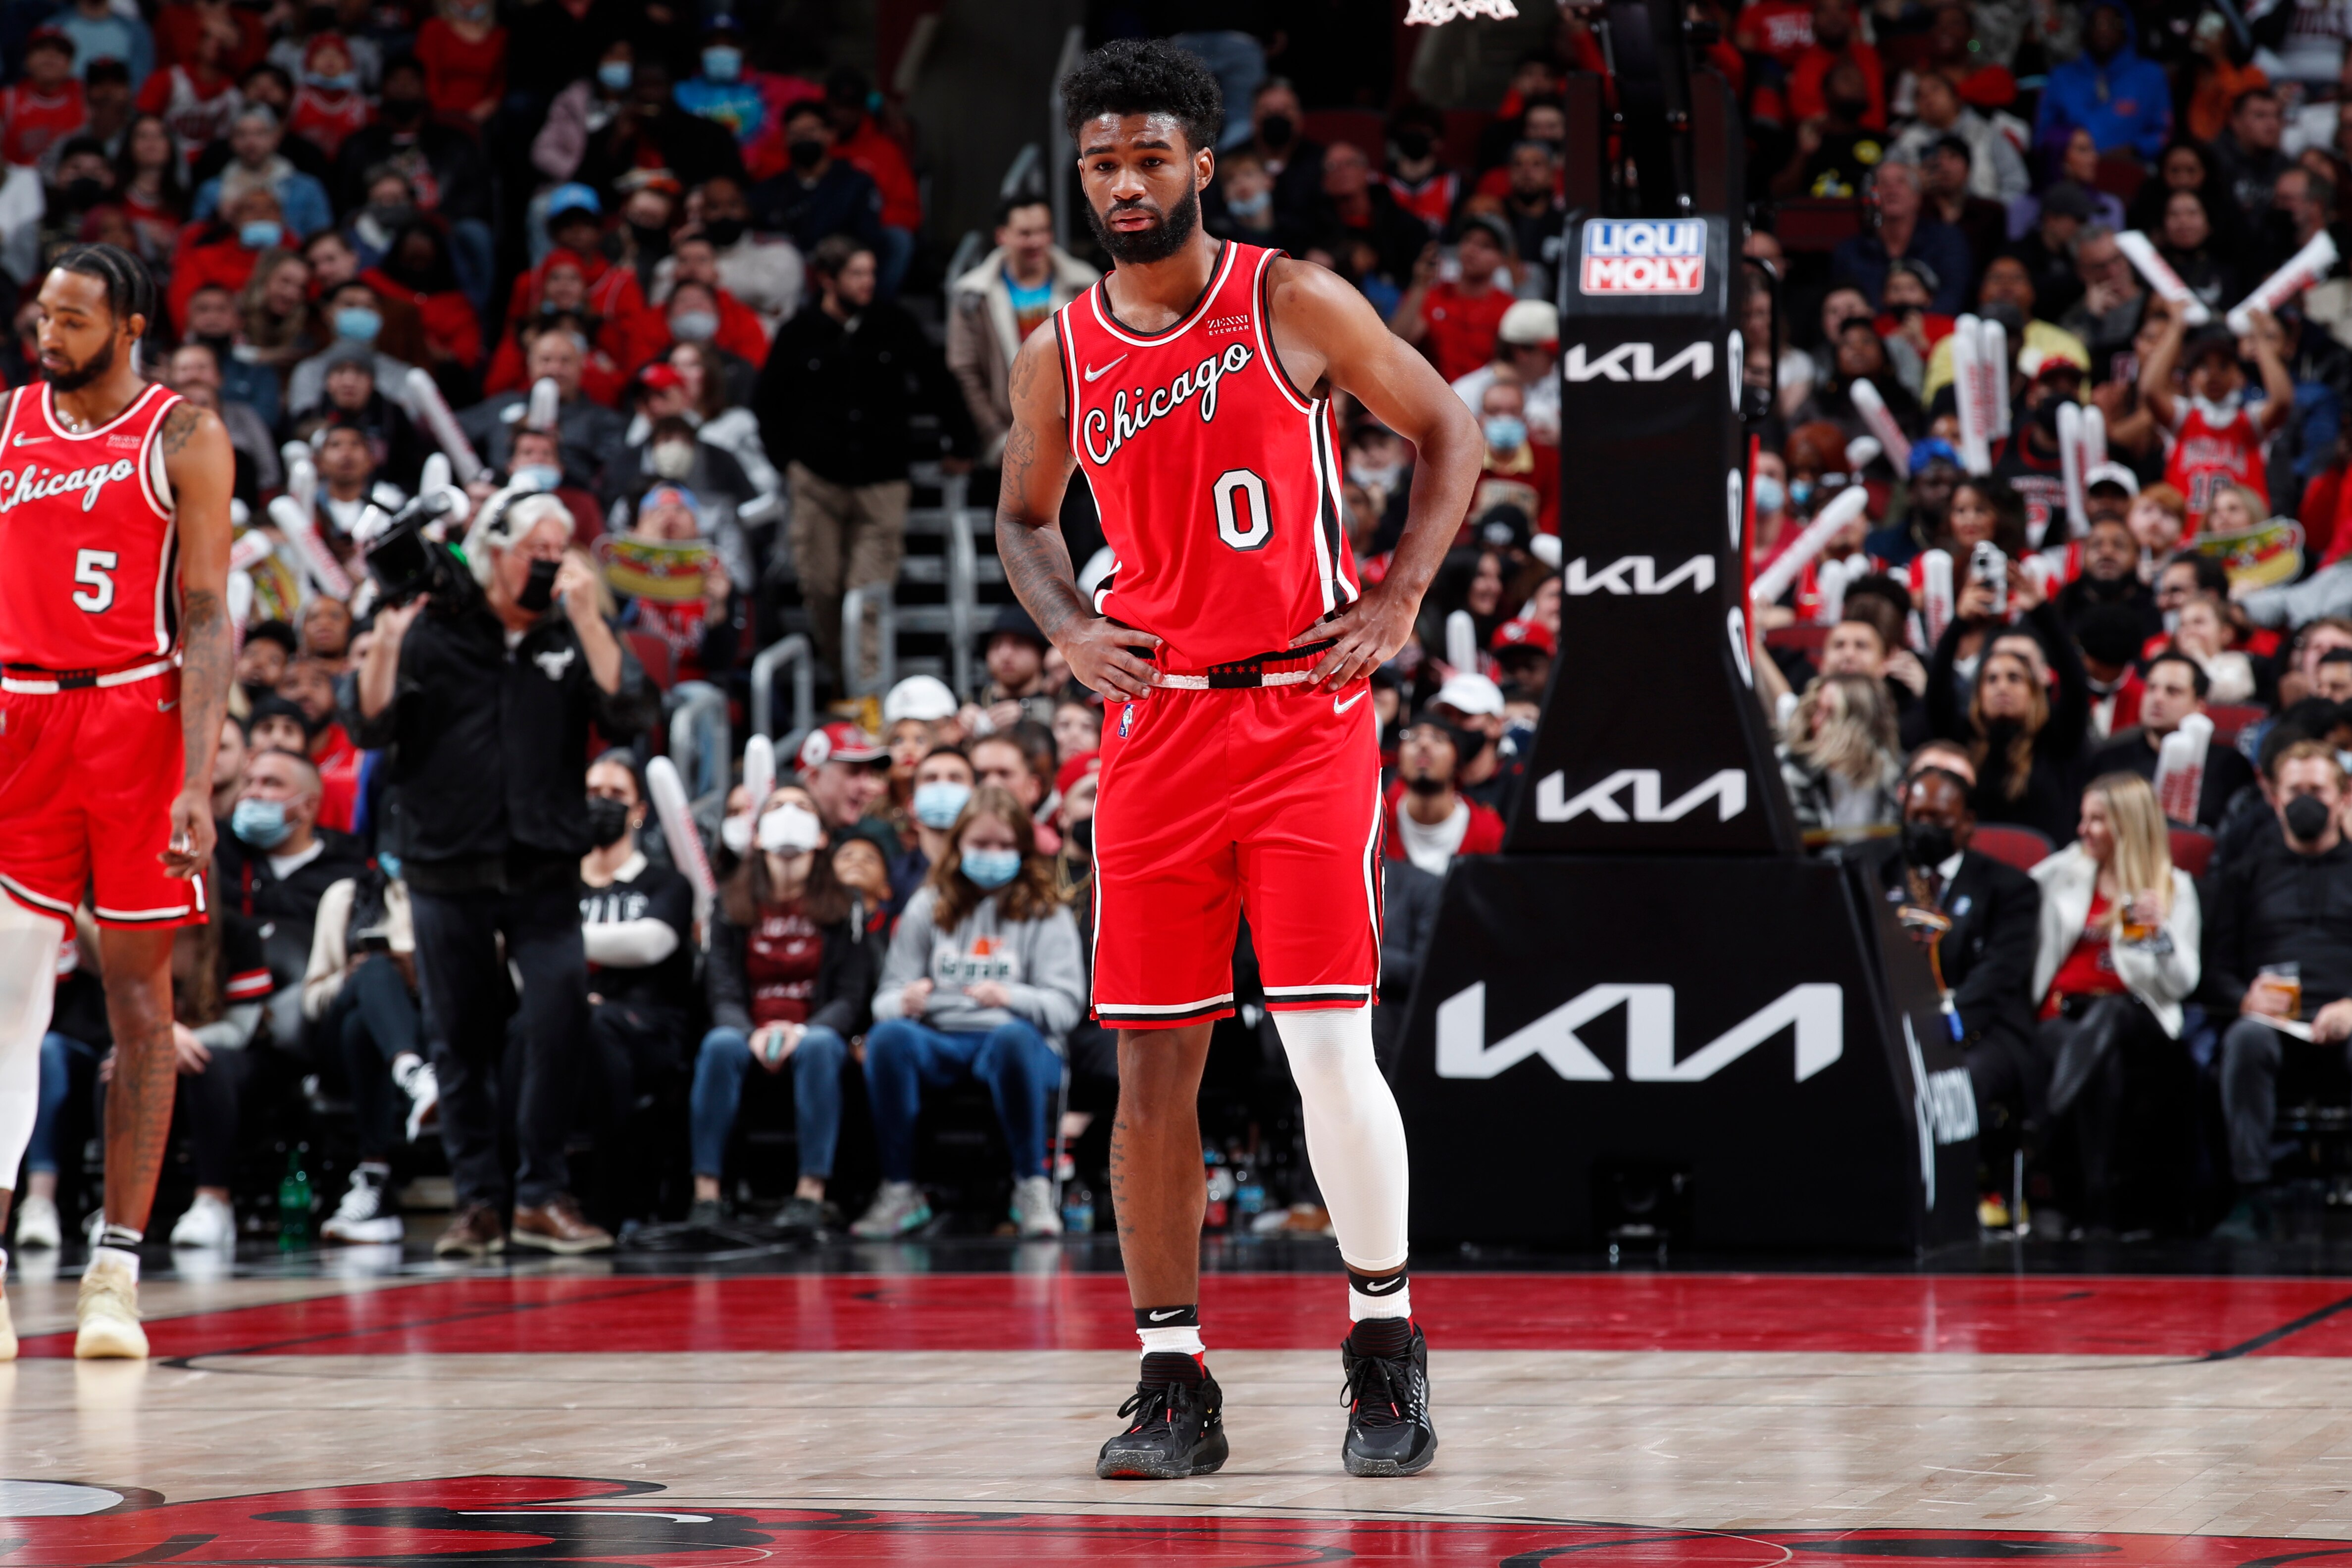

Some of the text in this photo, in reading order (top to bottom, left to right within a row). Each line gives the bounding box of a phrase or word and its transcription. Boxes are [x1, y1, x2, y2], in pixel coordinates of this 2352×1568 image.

[1591, 223, 1698, 255] LIQUI
[1589, 258, 1700, 289] MOLY
[1207, 314, 1248, 329] ZENNI
[1209, 325, 1249, 336] EYEWEAR
[1565, 342, 1713, 381] KIA
[1083, 343, 1253, 465] Chicago
[0, 458, 134, 513] Chicago
[1213, 468, 1273, 551] 0
[72, 549, 118, 613] 5
[1566, 555, 1715, 594] KIA
[1536, 769, 1746, 822] KIA
[1436, 981, 1843, 1083] KIA
